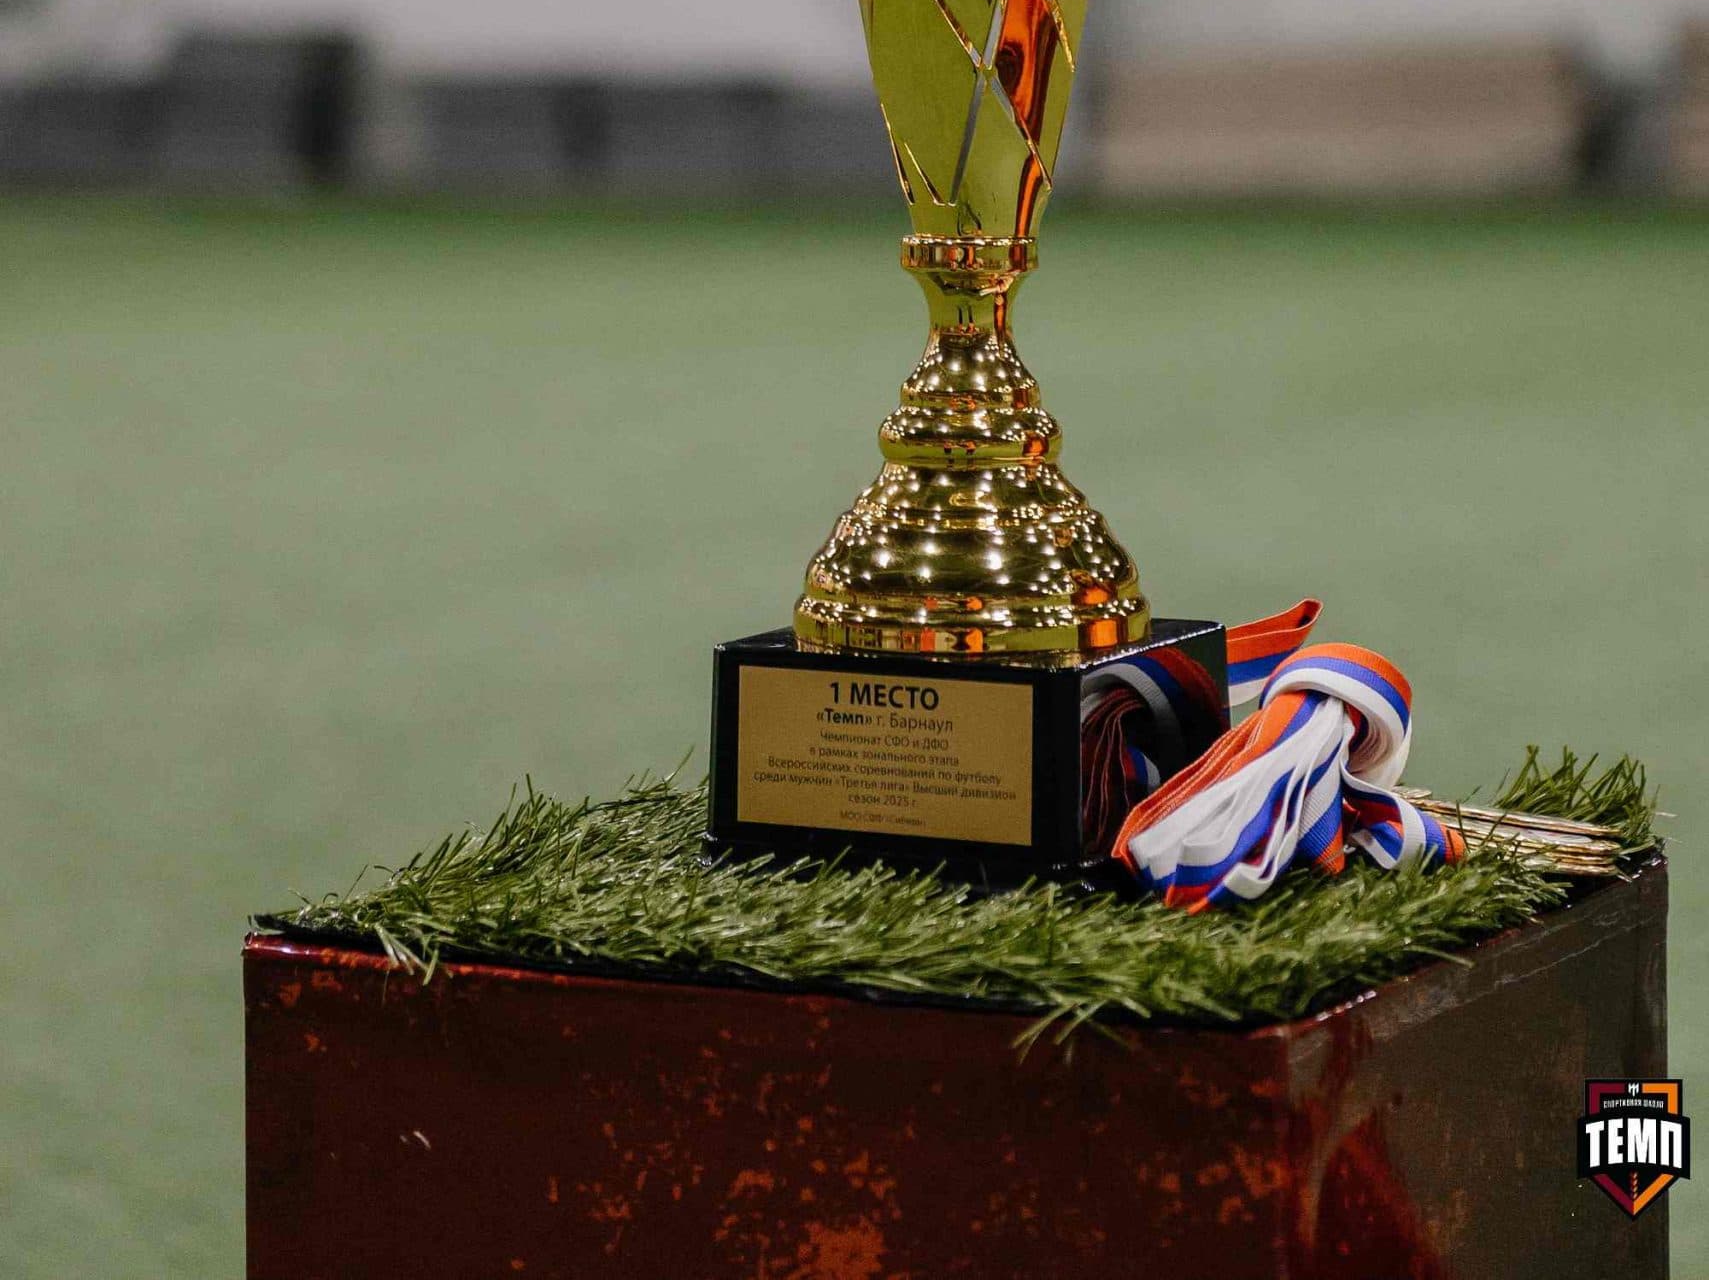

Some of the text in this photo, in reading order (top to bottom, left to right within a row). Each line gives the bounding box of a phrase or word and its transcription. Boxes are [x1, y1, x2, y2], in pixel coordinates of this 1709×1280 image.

[831, 682, 939, 710] 1 МЕСТО
[817, 708, 872, 725] «Темп»
[890, 712, 953, 734] Барнаул
[820, 729, 949, 751] Чемпионат СФО и ДФО
[818, 747, 858, 759] рамках
